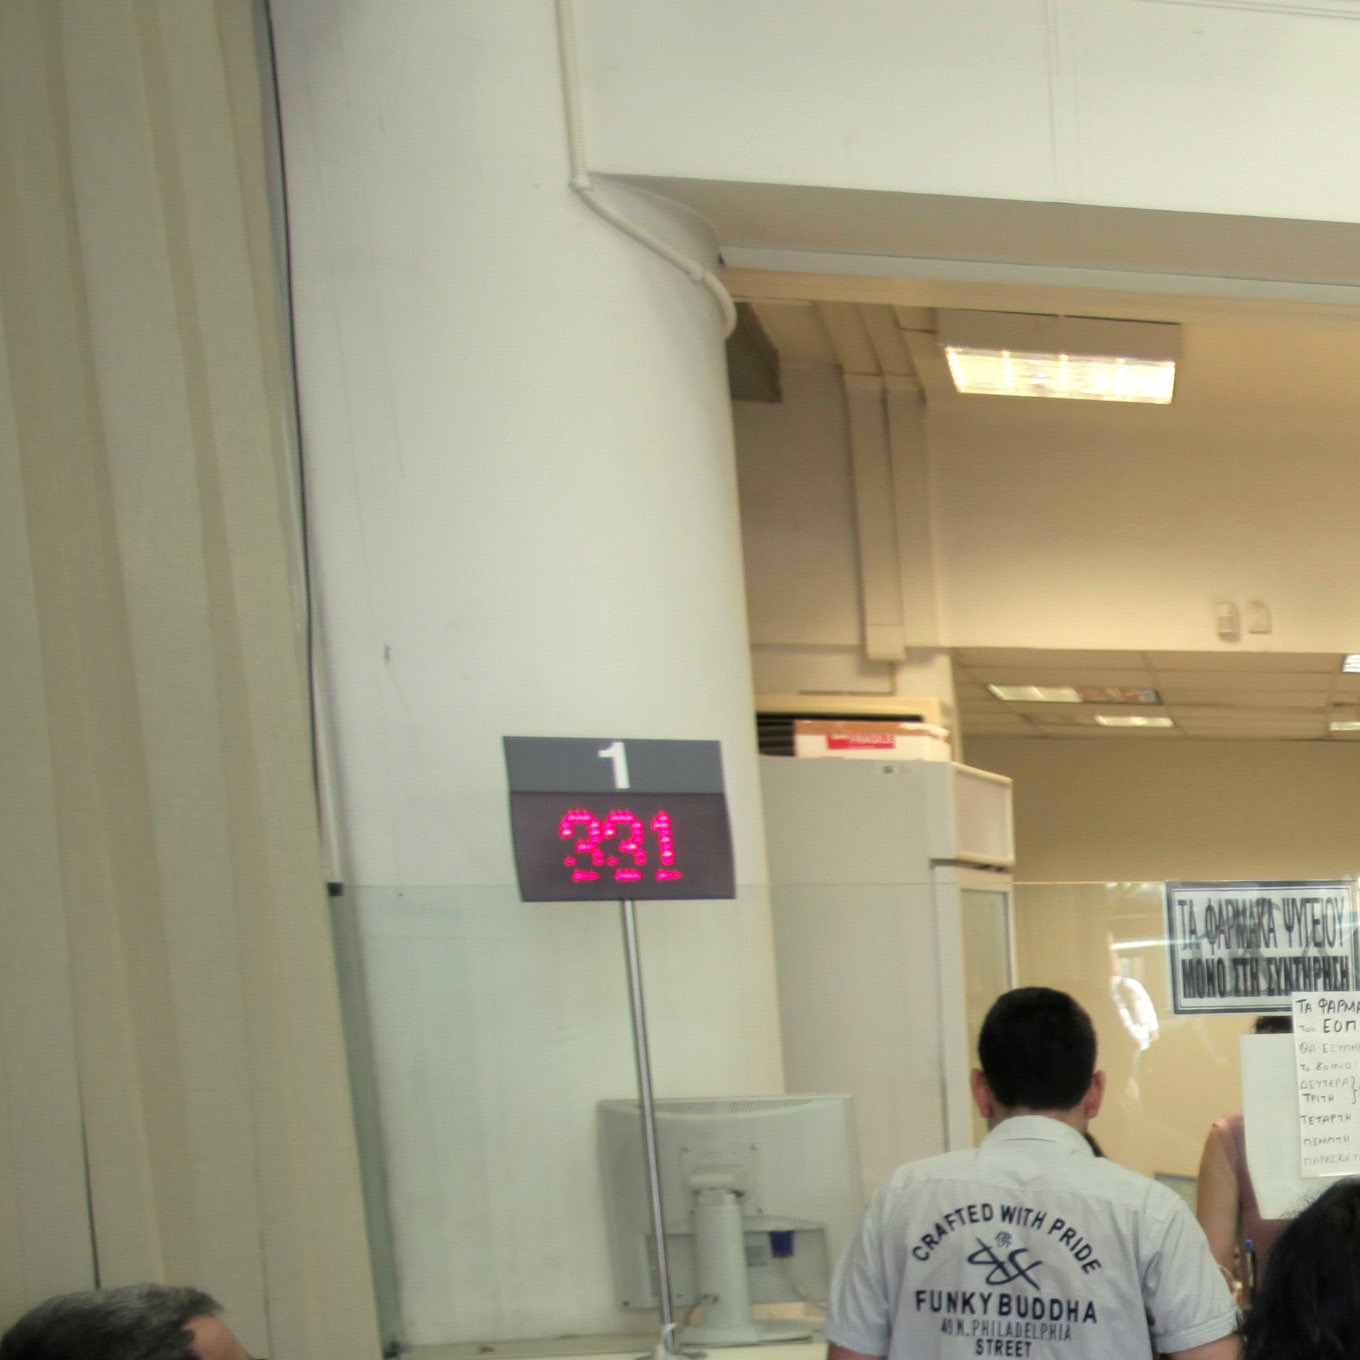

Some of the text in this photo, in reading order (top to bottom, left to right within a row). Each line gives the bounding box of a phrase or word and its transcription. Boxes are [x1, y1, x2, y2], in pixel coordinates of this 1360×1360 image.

[598, 741, 630, 789] 1
[560, 810, 683, 882] 331
[1178, 896, 1345, 955] ΤΑ ΦΑΡΜΑΚΑ ΨΥΓΕΙΟΥ
[1181, 955, 1350, 998] ΜΟΝΟ ΣΤΗ ΣΥΝΤΗΡΗΣΗ
[1296, 998, 1313, 1014] ΤΑ
[912, 1203, 1102, 1275] CRAFTED WITH PRIDE
[915, 1290, 1098, 1324] FUNKY BUDDHA
[976, 1338, 1032, 1358] STREET
